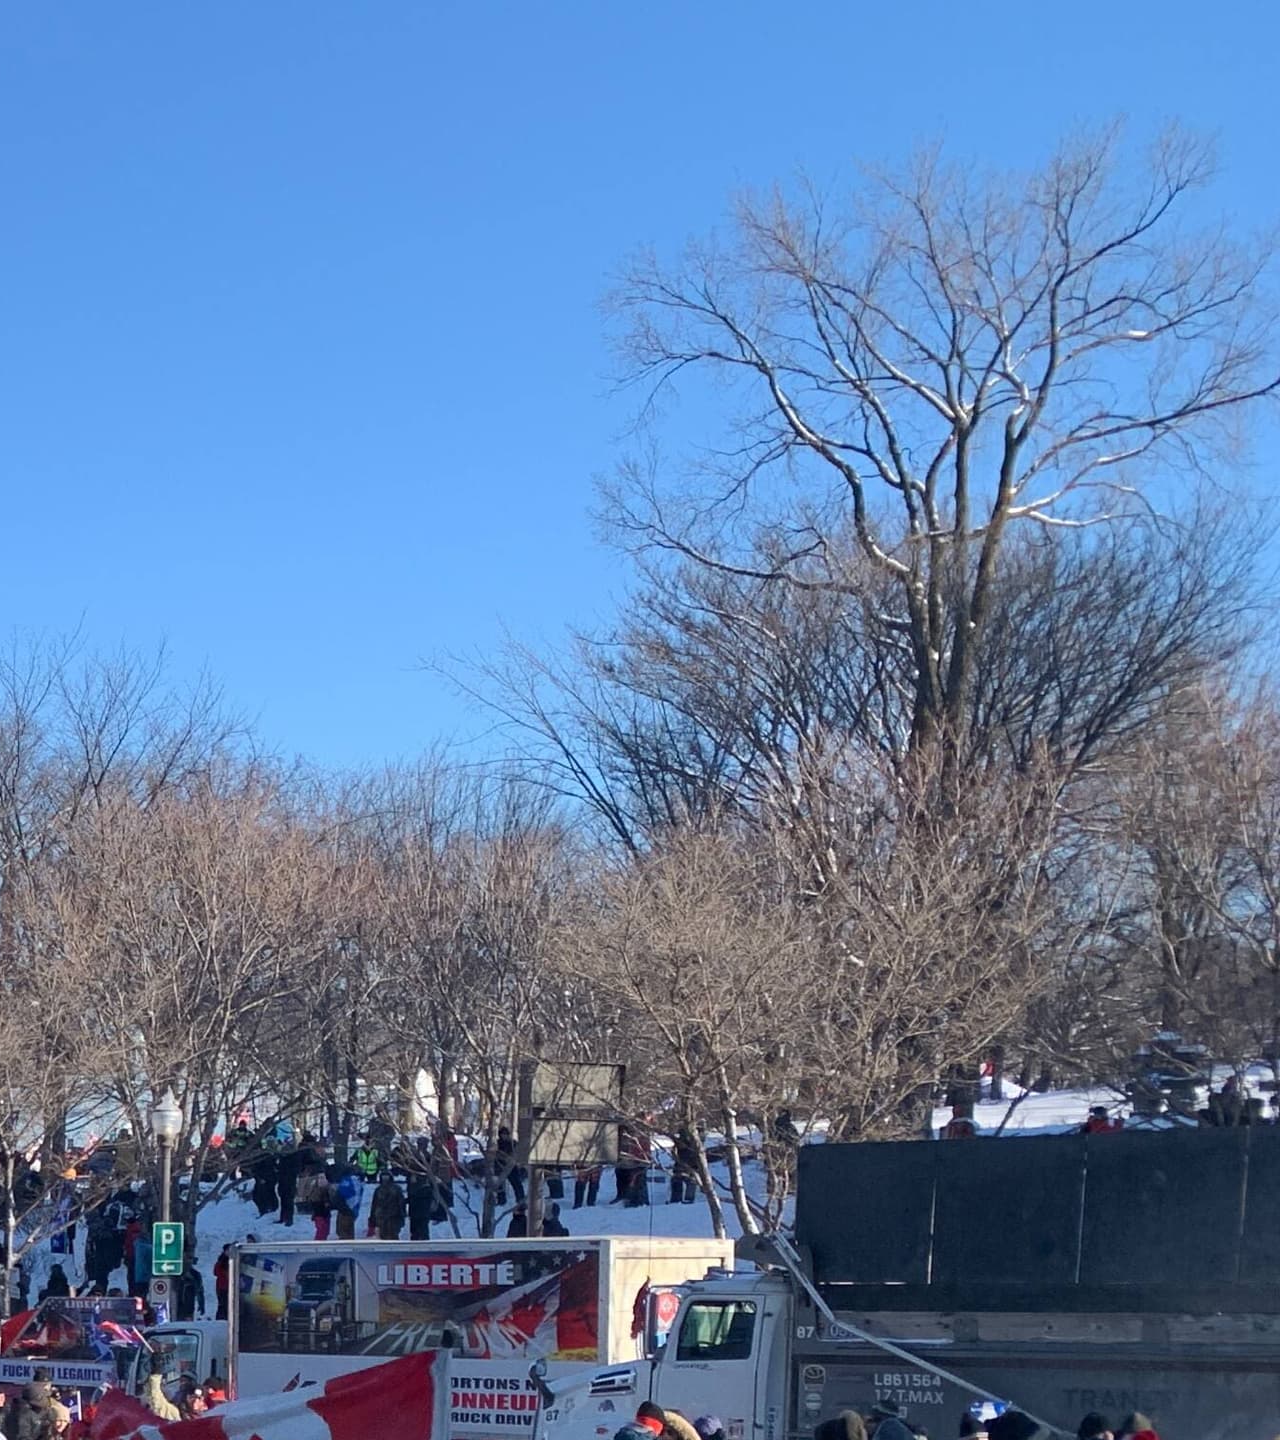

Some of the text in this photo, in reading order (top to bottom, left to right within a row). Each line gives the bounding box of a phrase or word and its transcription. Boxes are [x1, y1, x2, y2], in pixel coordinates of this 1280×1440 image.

[161, 1228, 175, 1255] P
[378, 1260, 515, 1286] LIBERTÉ
[2, 1364, 31, 1377] FUCK
[57, 1367, 103, 1381] LEGAULT
[544, 1410, 560, 1422] 87
